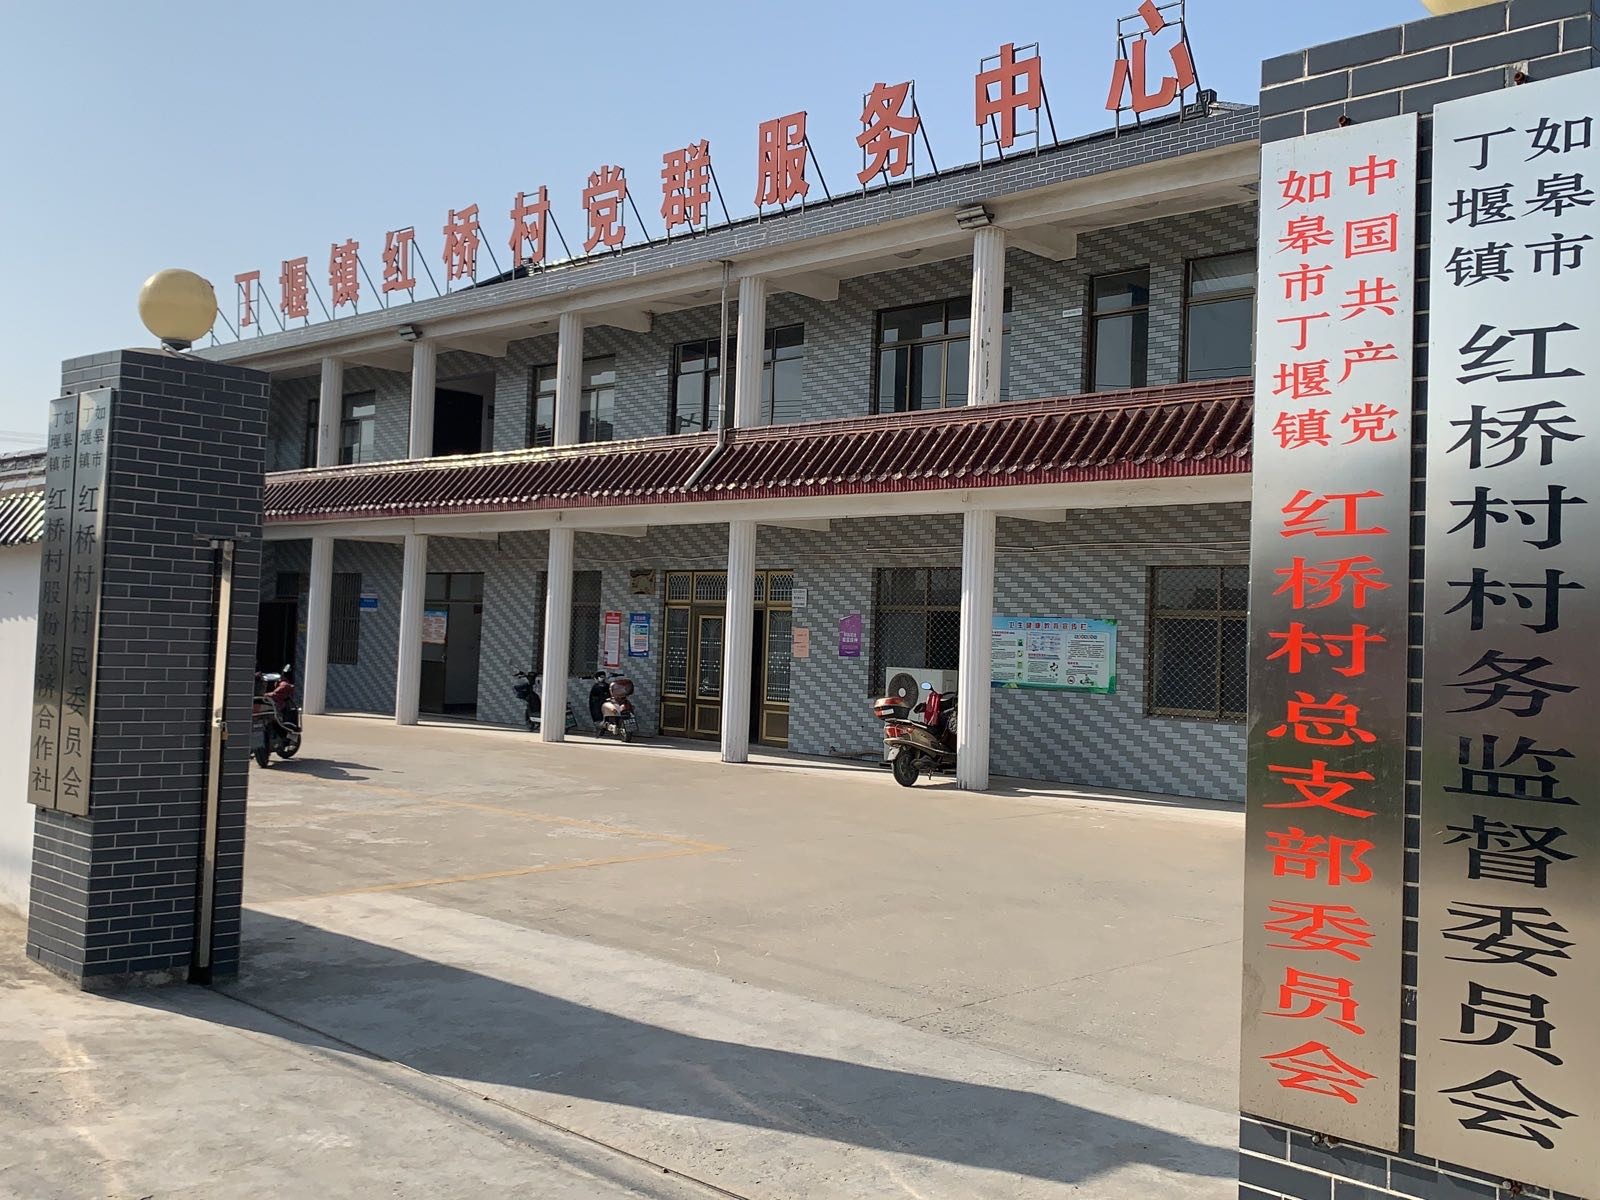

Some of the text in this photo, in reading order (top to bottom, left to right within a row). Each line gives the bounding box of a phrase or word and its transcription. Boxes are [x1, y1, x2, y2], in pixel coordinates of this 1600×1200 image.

[234, 0, 1195, 327] 丁堰镇红桥村党群服务中心
[1271, 169, 1334, 450] 如皋市丁堰镇
[1337, 154, 1400, 446] 中国共产党
[1444, 126, 1517, 287] 丁堰镇
[1520, 116, 1595, 276] 如皋市
[49, 413, 62, 472] 丁堰镇
[78, 407, 94, 469] 丁堰镇
[31, 487, 67, 793] 红桥村股份经济合作社
[62, 485, 98, 799] 红桥村村民委员会
[1436, 321, 1588, 1150] 红桥村村务监督委员会
[1260, 488, 1392, 1104] 红桥村总支部委员会
